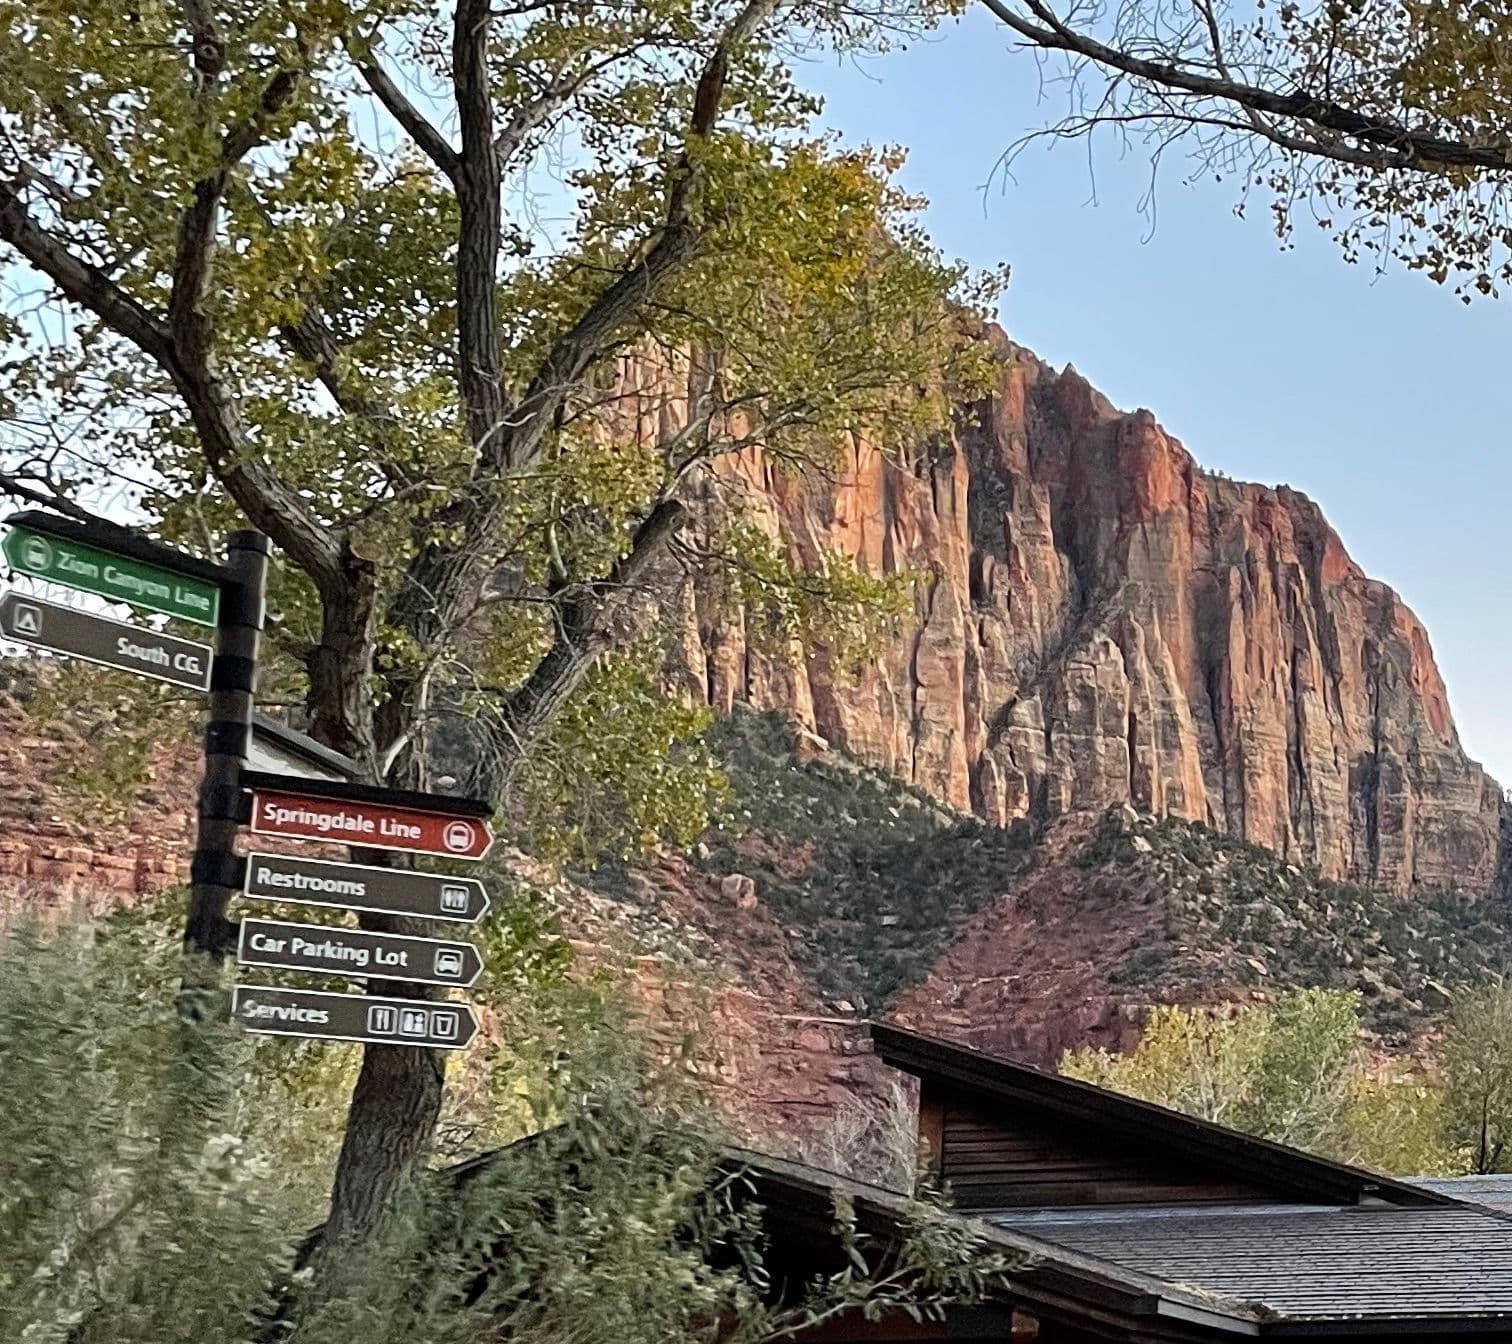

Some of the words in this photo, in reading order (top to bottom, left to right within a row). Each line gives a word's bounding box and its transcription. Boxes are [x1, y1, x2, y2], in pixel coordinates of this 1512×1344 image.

[56, 551, 99, 578] Zion
[103, 566, 170, 599] Canyon
[175, 586, 210, 611] Line
[117, 637, 170, 667] South
[174, 653, 203, 676] CG.
[263, 803, 375, 833] Springdale
[380, 818, 422, 839] Line
[257, 867, 366, 896] Restrooms
[250, 933, 287, 953] Car
[291, 937, 369, 966] Parking
[375, 947, 408, 967] Lot
[241, 999, 329, 1024] Services
